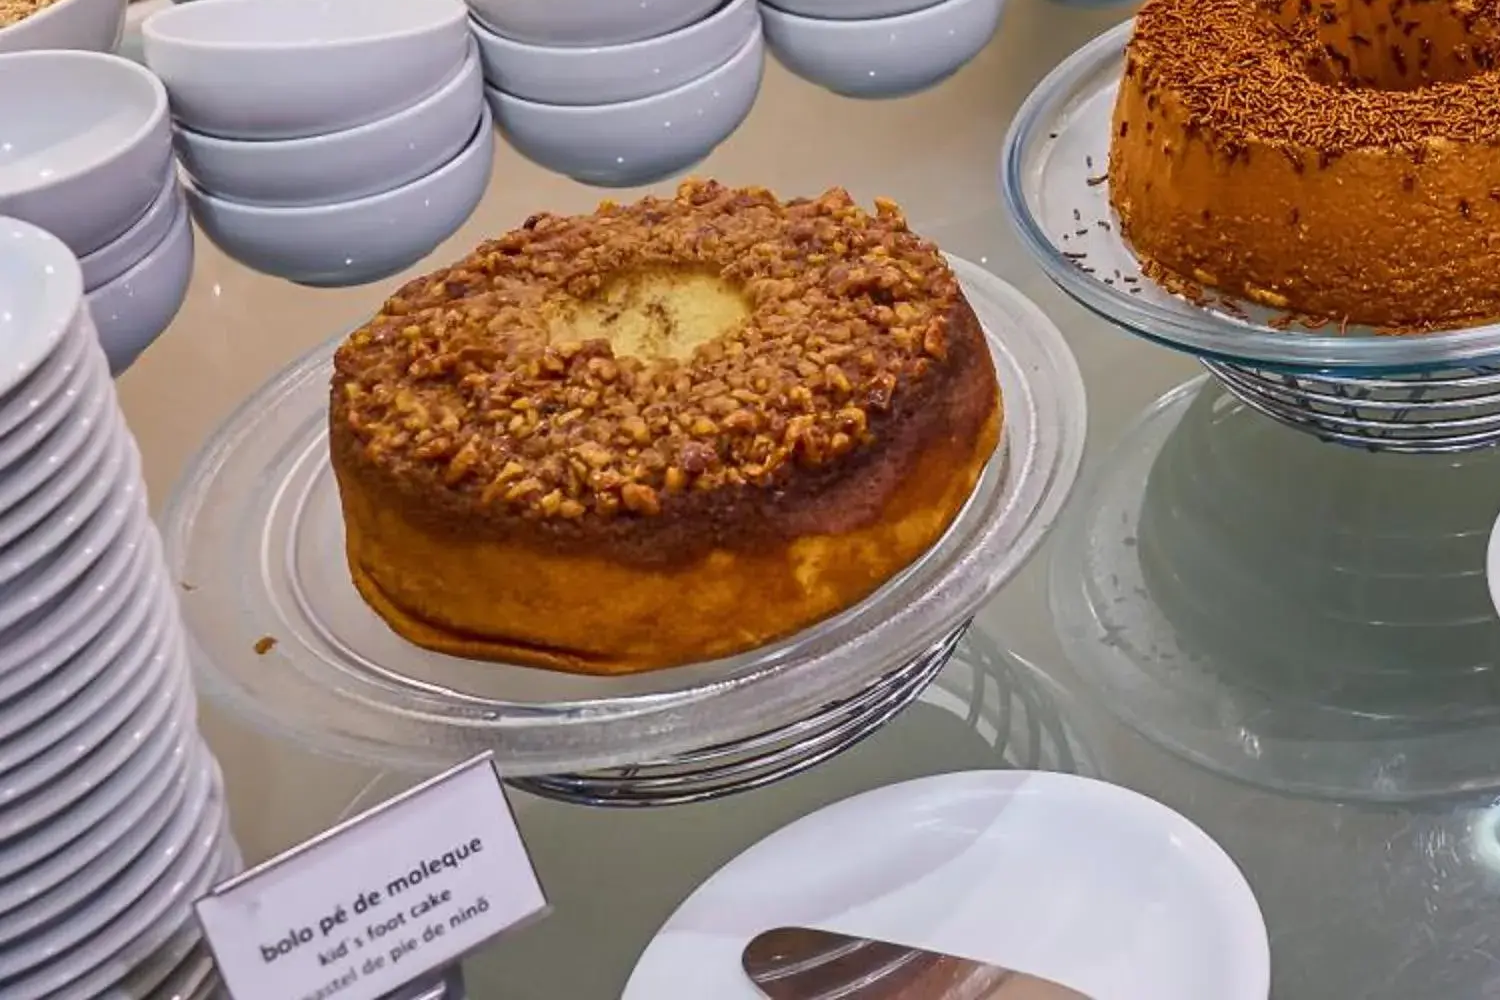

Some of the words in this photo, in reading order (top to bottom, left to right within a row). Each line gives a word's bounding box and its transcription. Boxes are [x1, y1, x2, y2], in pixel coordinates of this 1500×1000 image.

[259, 927, 314, 963] bolo
[319, 904, 348, 937] pé
[353, 893, 381, 914] de
[386, 838, 482, 897] moleque
[367, 912, 406, 941] foot
[410, 890, 452, 918] cake
[300, 967, 357, 1000] astel
[362, 957, 385, 976] de
[390, 937, 418, 964] pie
[422, 923, 445, 944] de
